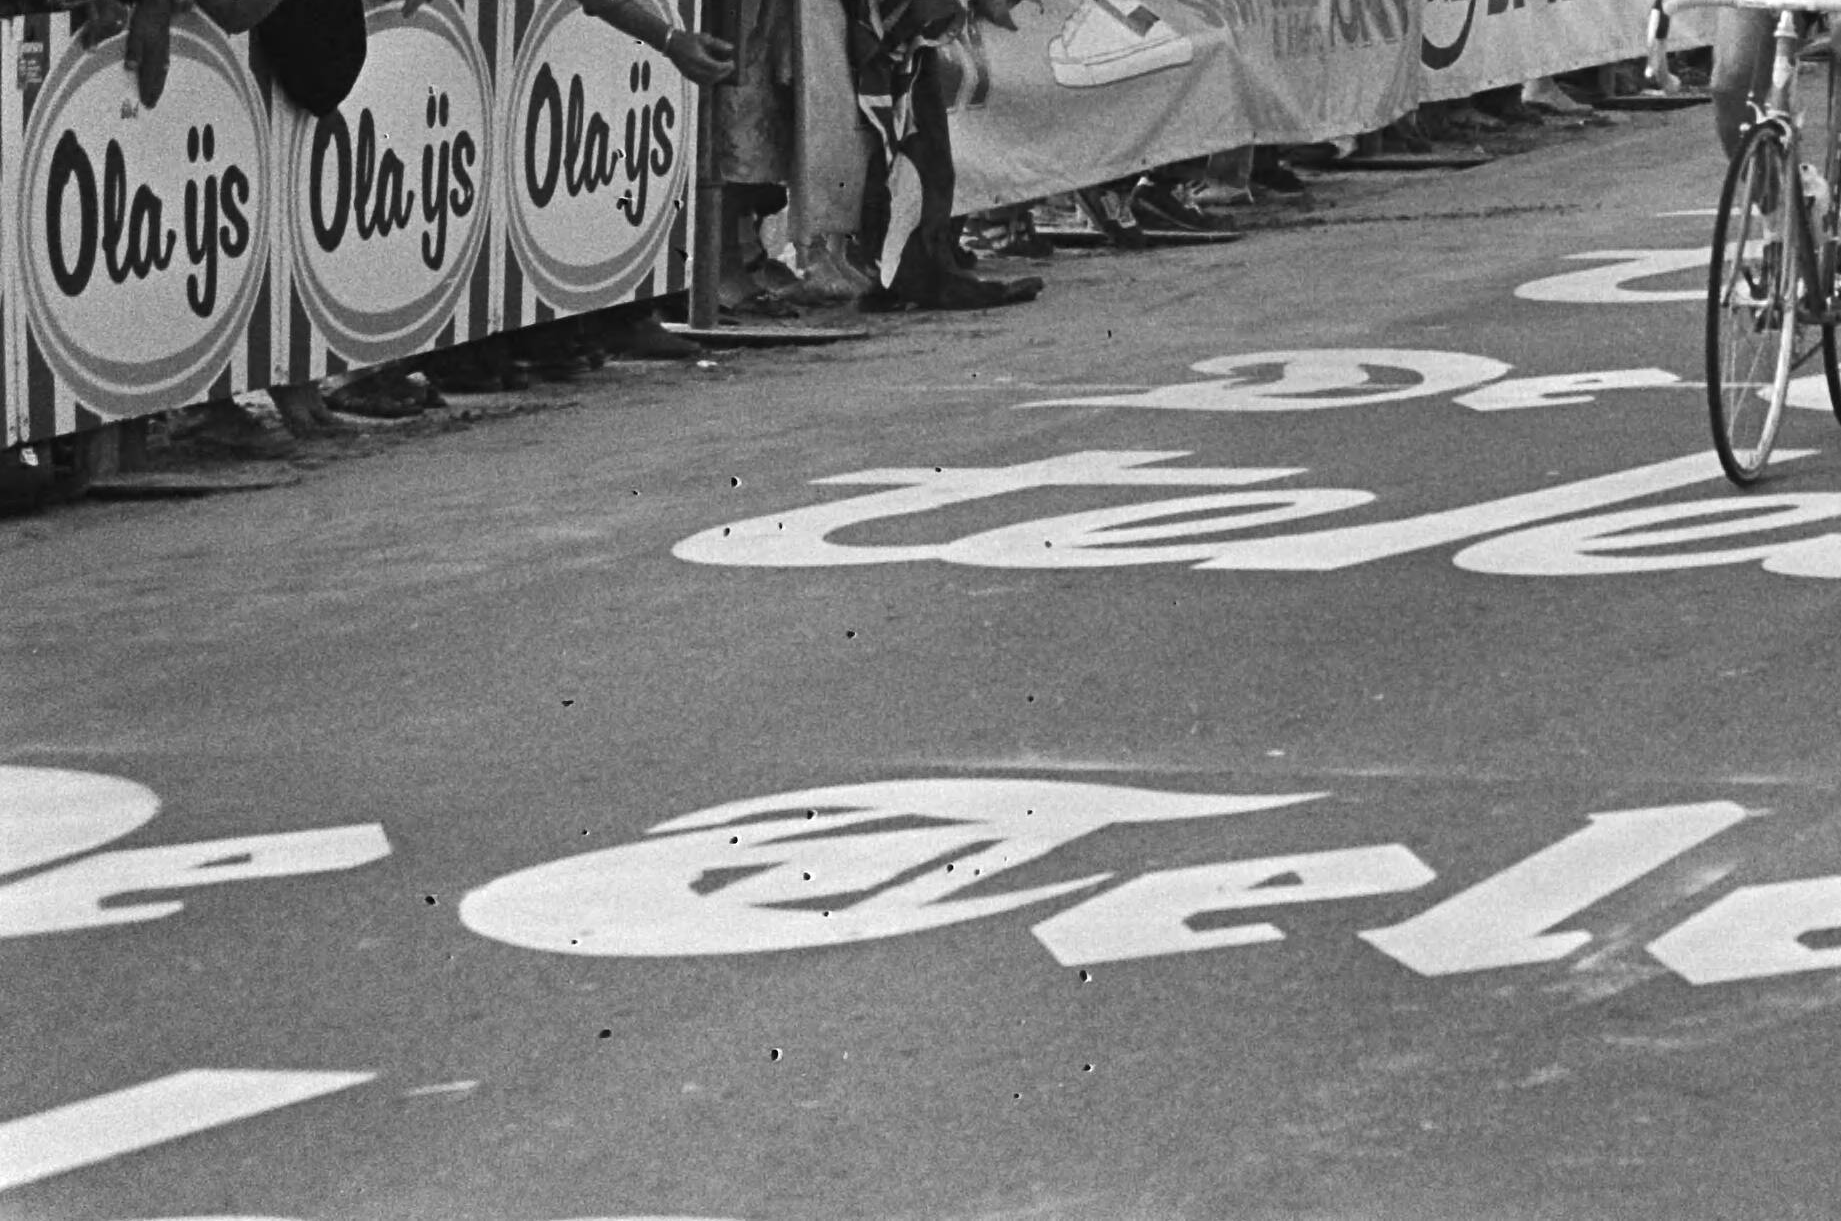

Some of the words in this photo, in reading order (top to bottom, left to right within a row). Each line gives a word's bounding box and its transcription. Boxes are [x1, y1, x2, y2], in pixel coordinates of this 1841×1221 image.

[308, 109, 414, 252] Ola
[523, 62, 619, 208] Ola
[46, 129, 176, 297] Ola
[1010, 347, 1684, 412] De
